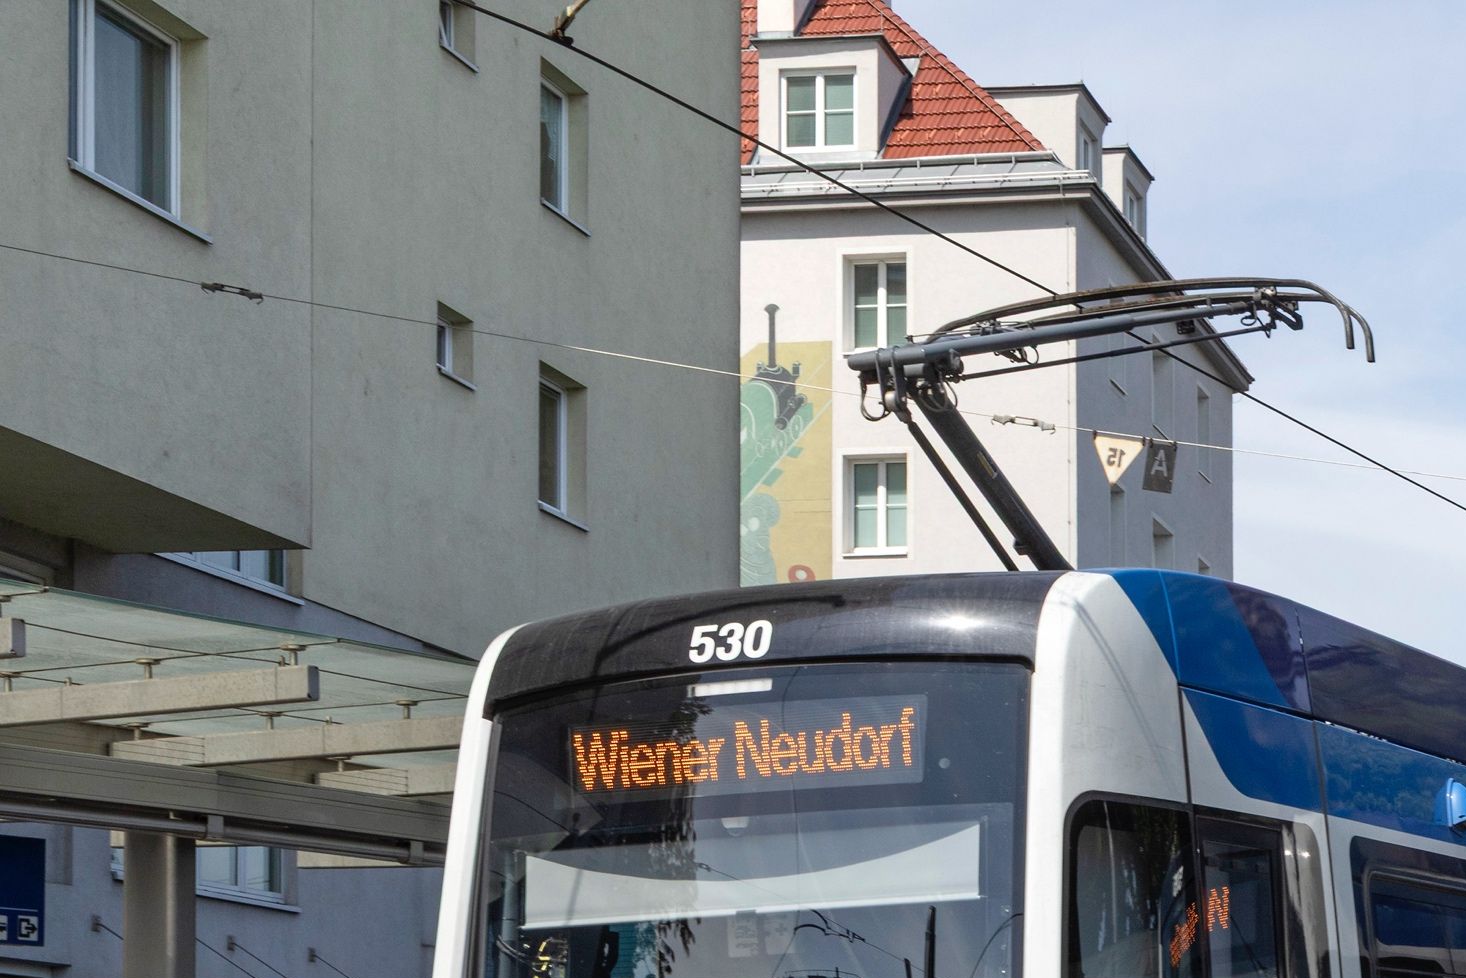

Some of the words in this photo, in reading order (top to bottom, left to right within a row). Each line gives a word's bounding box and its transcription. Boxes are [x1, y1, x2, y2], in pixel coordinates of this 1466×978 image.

[1150, 449, 1168, 477] A
[688, 620, 773, 663] 530
[573, 730, 726, 791] Wiener
[734, 706, 915, 779] Neudorf
